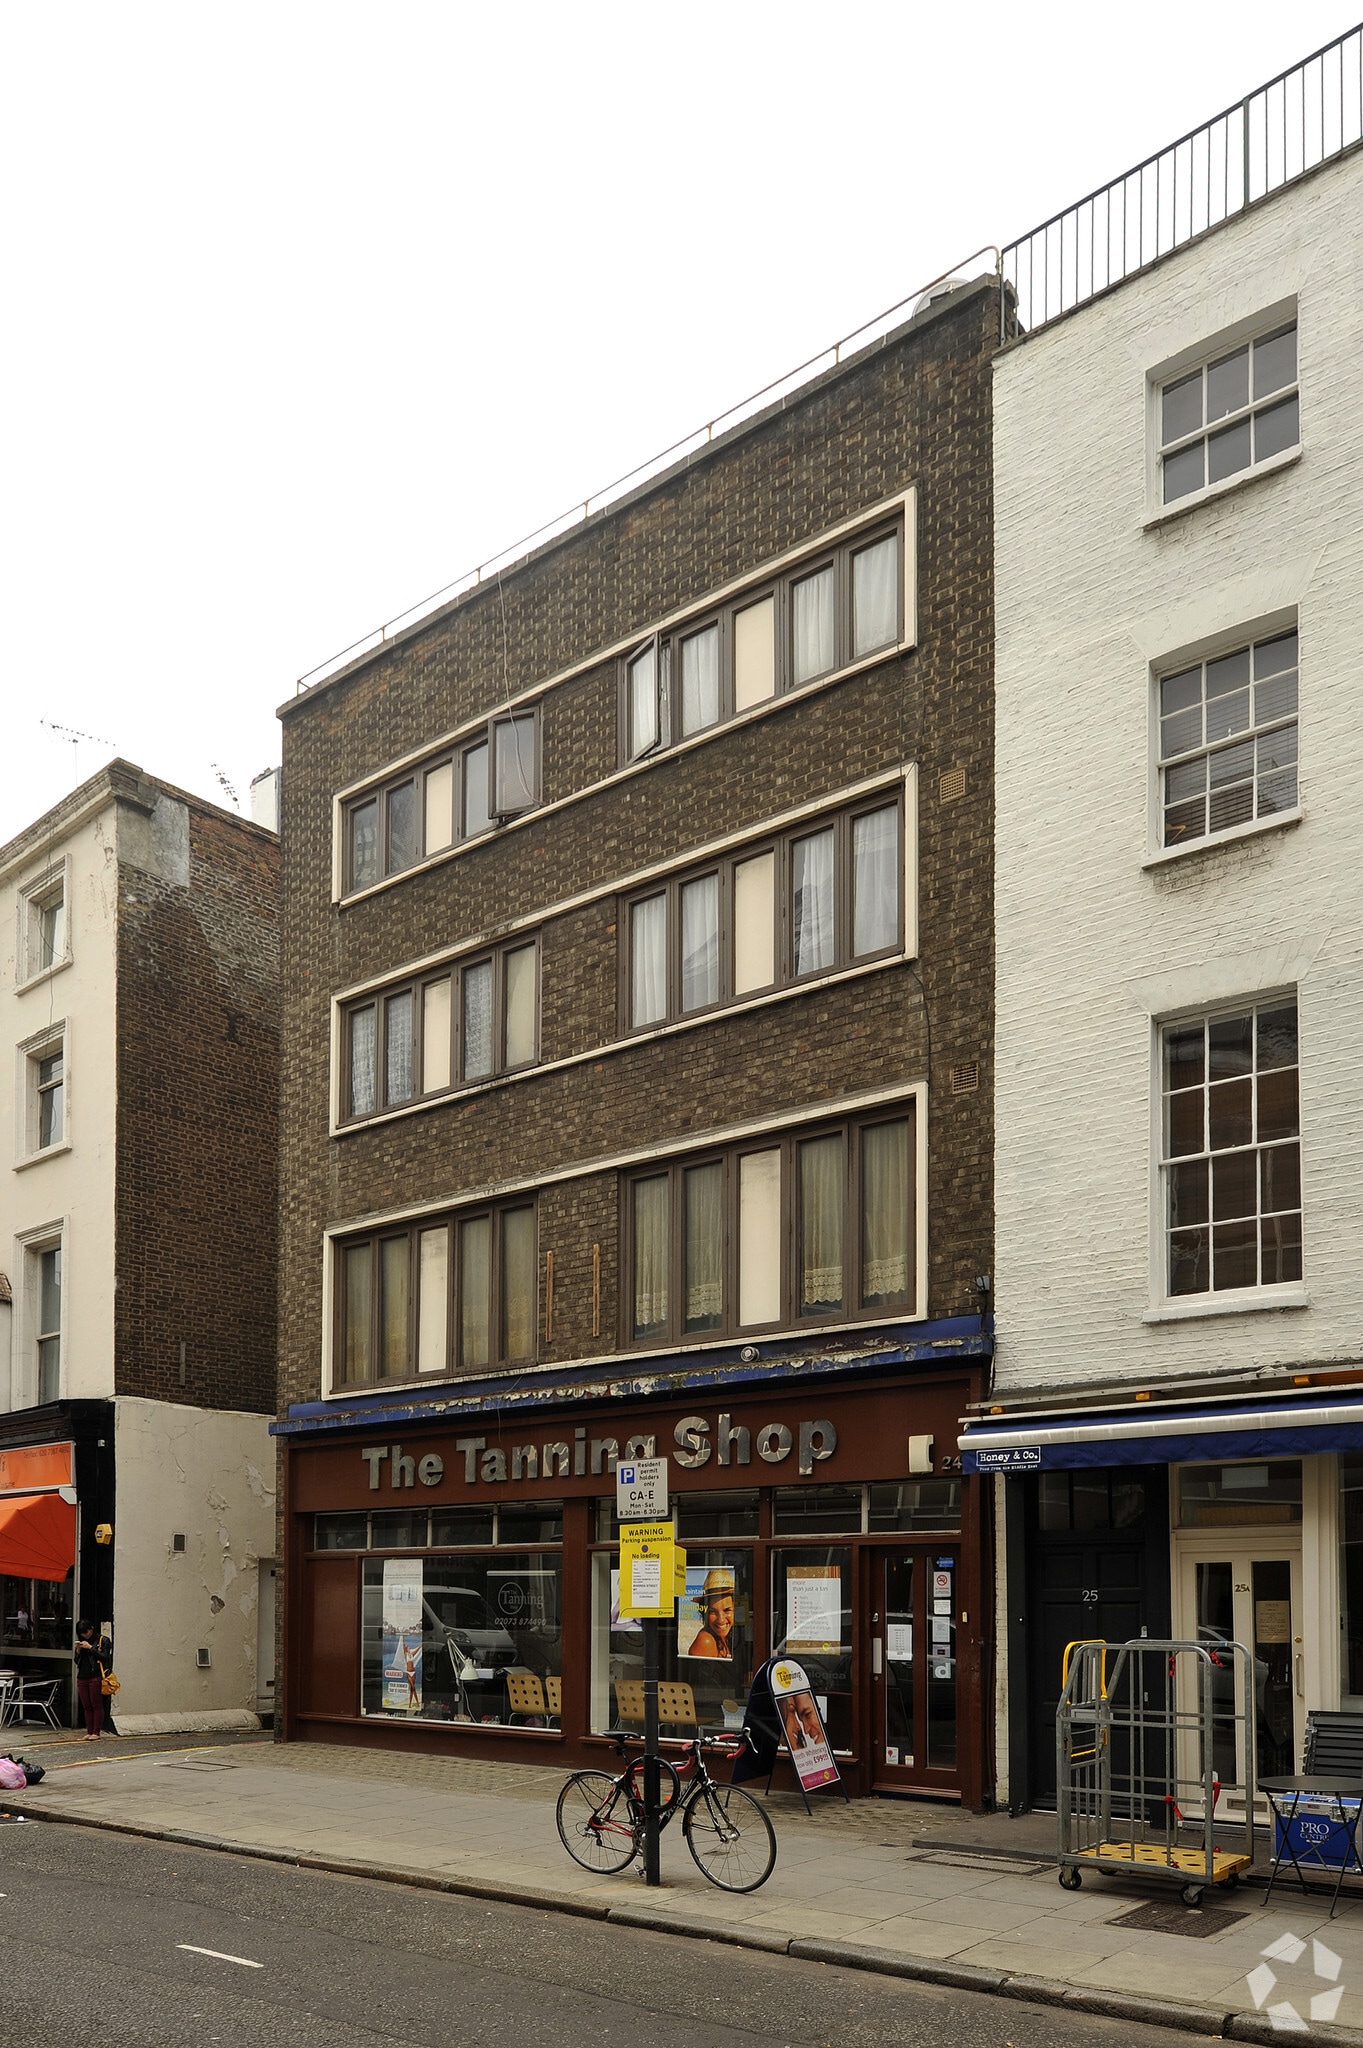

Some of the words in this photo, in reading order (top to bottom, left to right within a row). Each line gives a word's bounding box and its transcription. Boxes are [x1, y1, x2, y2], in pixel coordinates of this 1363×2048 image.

[362, 1445, 444, 1490] The
[456, 1427, 656, 1483] Tanning
[672, 1413, 837, 1476] Shop
[980, 1453, 1010, 1463] Honey
[1013, 1450, 1020, 1460] &
[1023, 1451, 1038, 1459] Co.
[941, 1456, 963, 1470] 24
[623, 1468, 633, 1483] P
[628, 1528, 664, 1537] WARNING
[501, 1590, 544, 1609] Tanning
[1082, 1590, 1098, 1601] 25
[682, 1604, 709, 1613] holiday
[777, 1670, 803, 1682] Tanning
[1301, 1822, 1330, 1835] PRO
